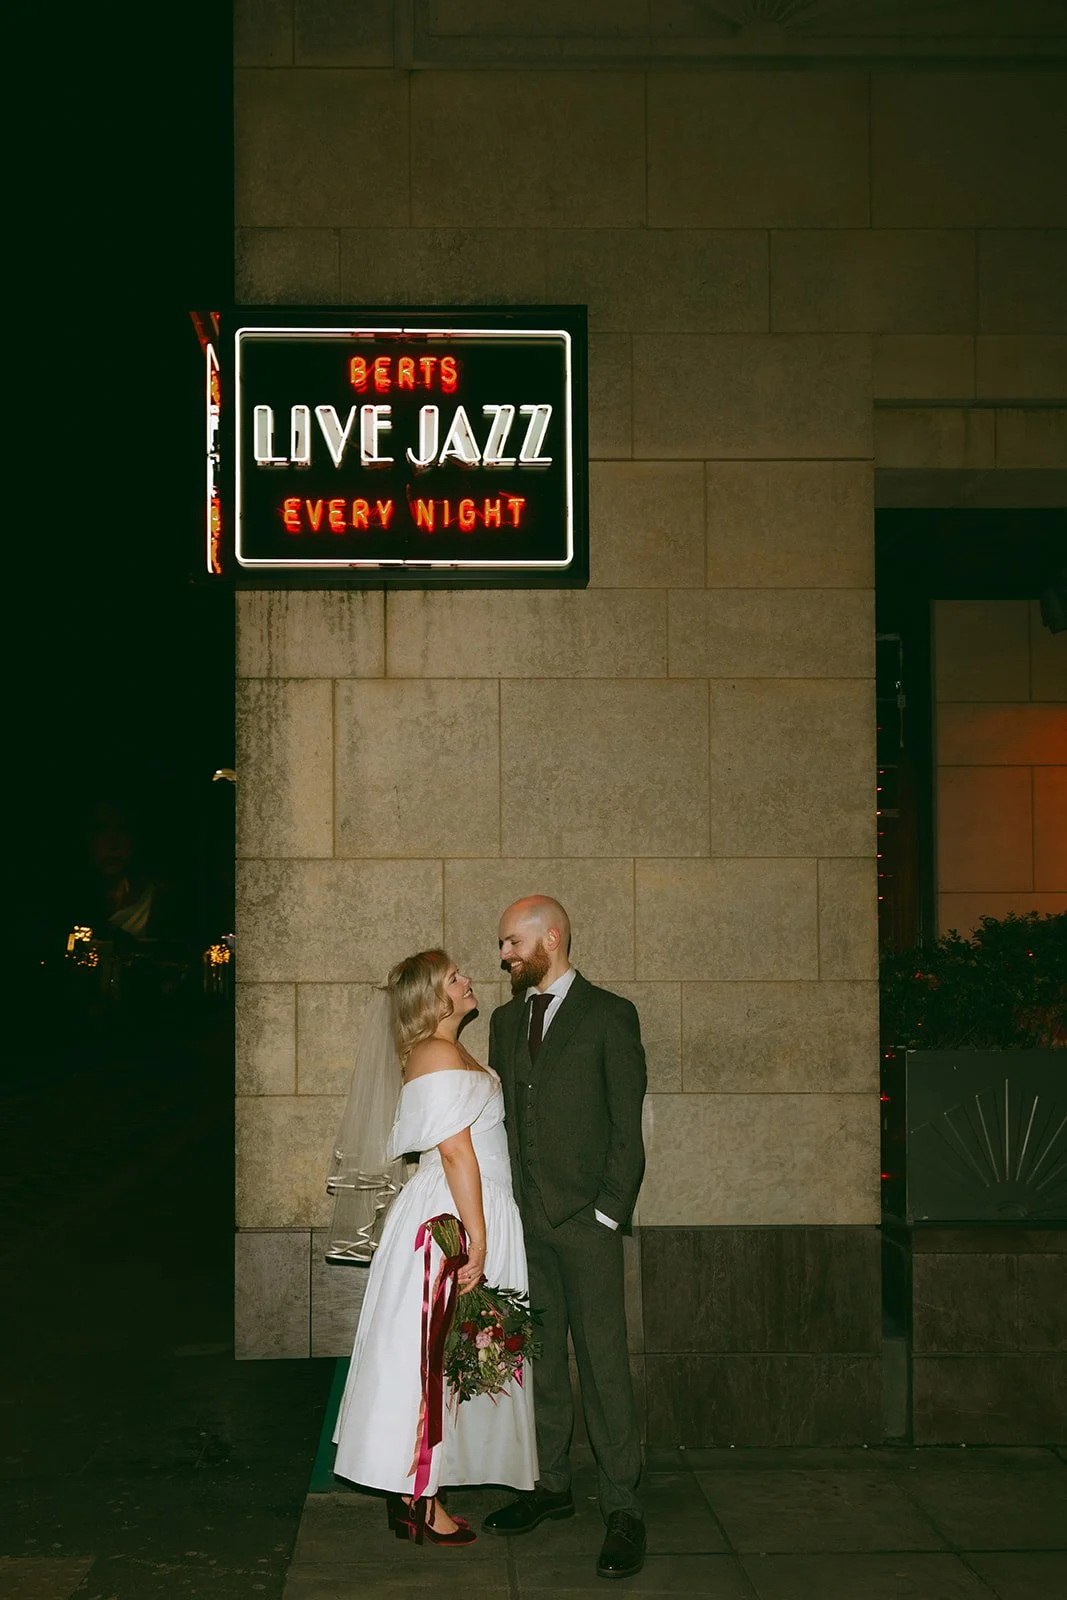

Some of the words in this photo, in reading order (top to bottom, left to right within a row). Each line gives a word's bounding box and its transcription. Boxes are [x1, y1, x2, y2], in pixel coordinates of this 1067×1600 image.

[350, 356, 458, 388] BERTS
[253, 404, 394, 466] LIVE
[407, 404, 553, 466] JAZZ
[283, 498, 393, 529] EVERY
[416, 498, 526, 529] NIGHT
